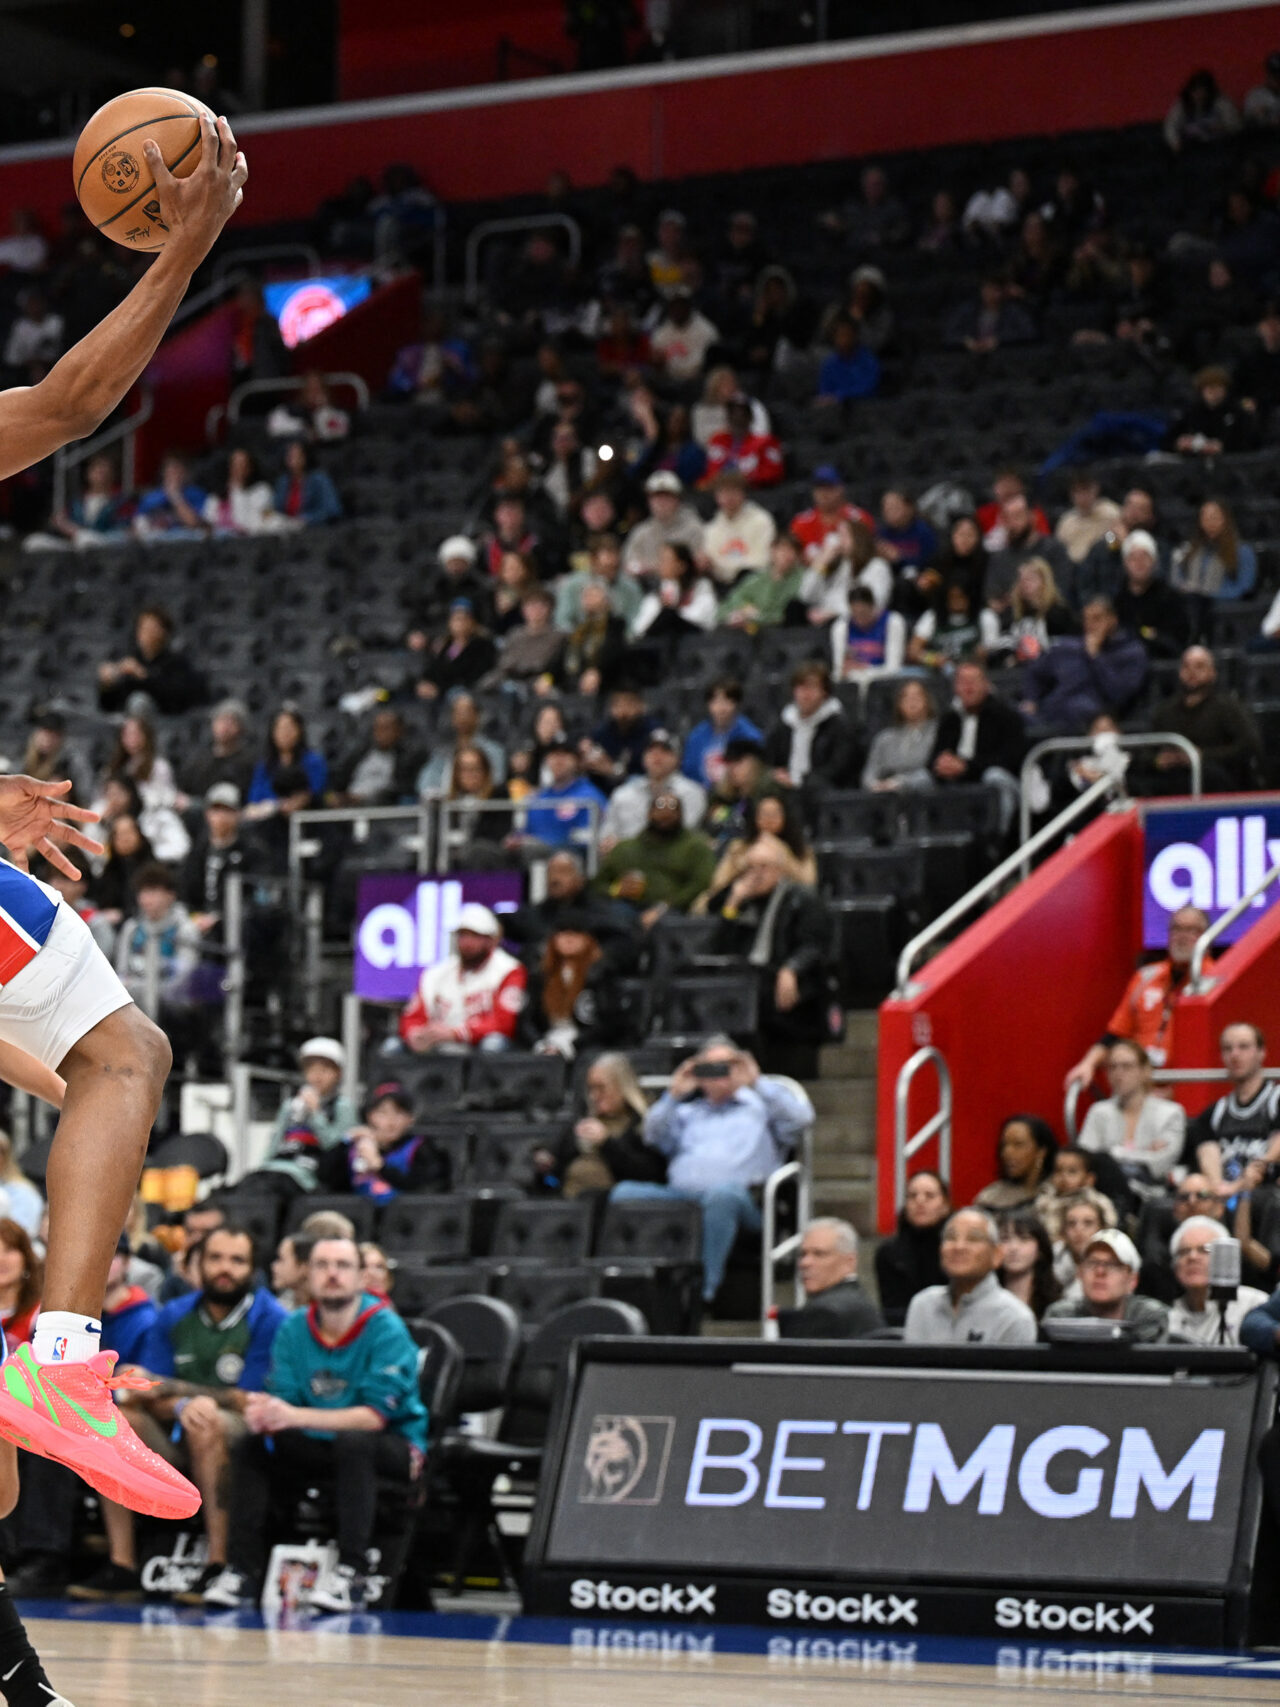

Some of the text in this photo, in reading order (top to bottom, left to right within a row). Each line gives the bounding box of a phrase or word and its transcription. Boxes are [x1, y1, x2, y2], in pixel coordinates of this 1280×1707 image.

[358, 879, 518, 970] all
[685, 1418, 1226, 1521] BETMGM
[569, 1579, 717, 1614] StockX
[767, 1588, 918, 1626] StockX
[994, 1597, 1155, 1635] StockX
